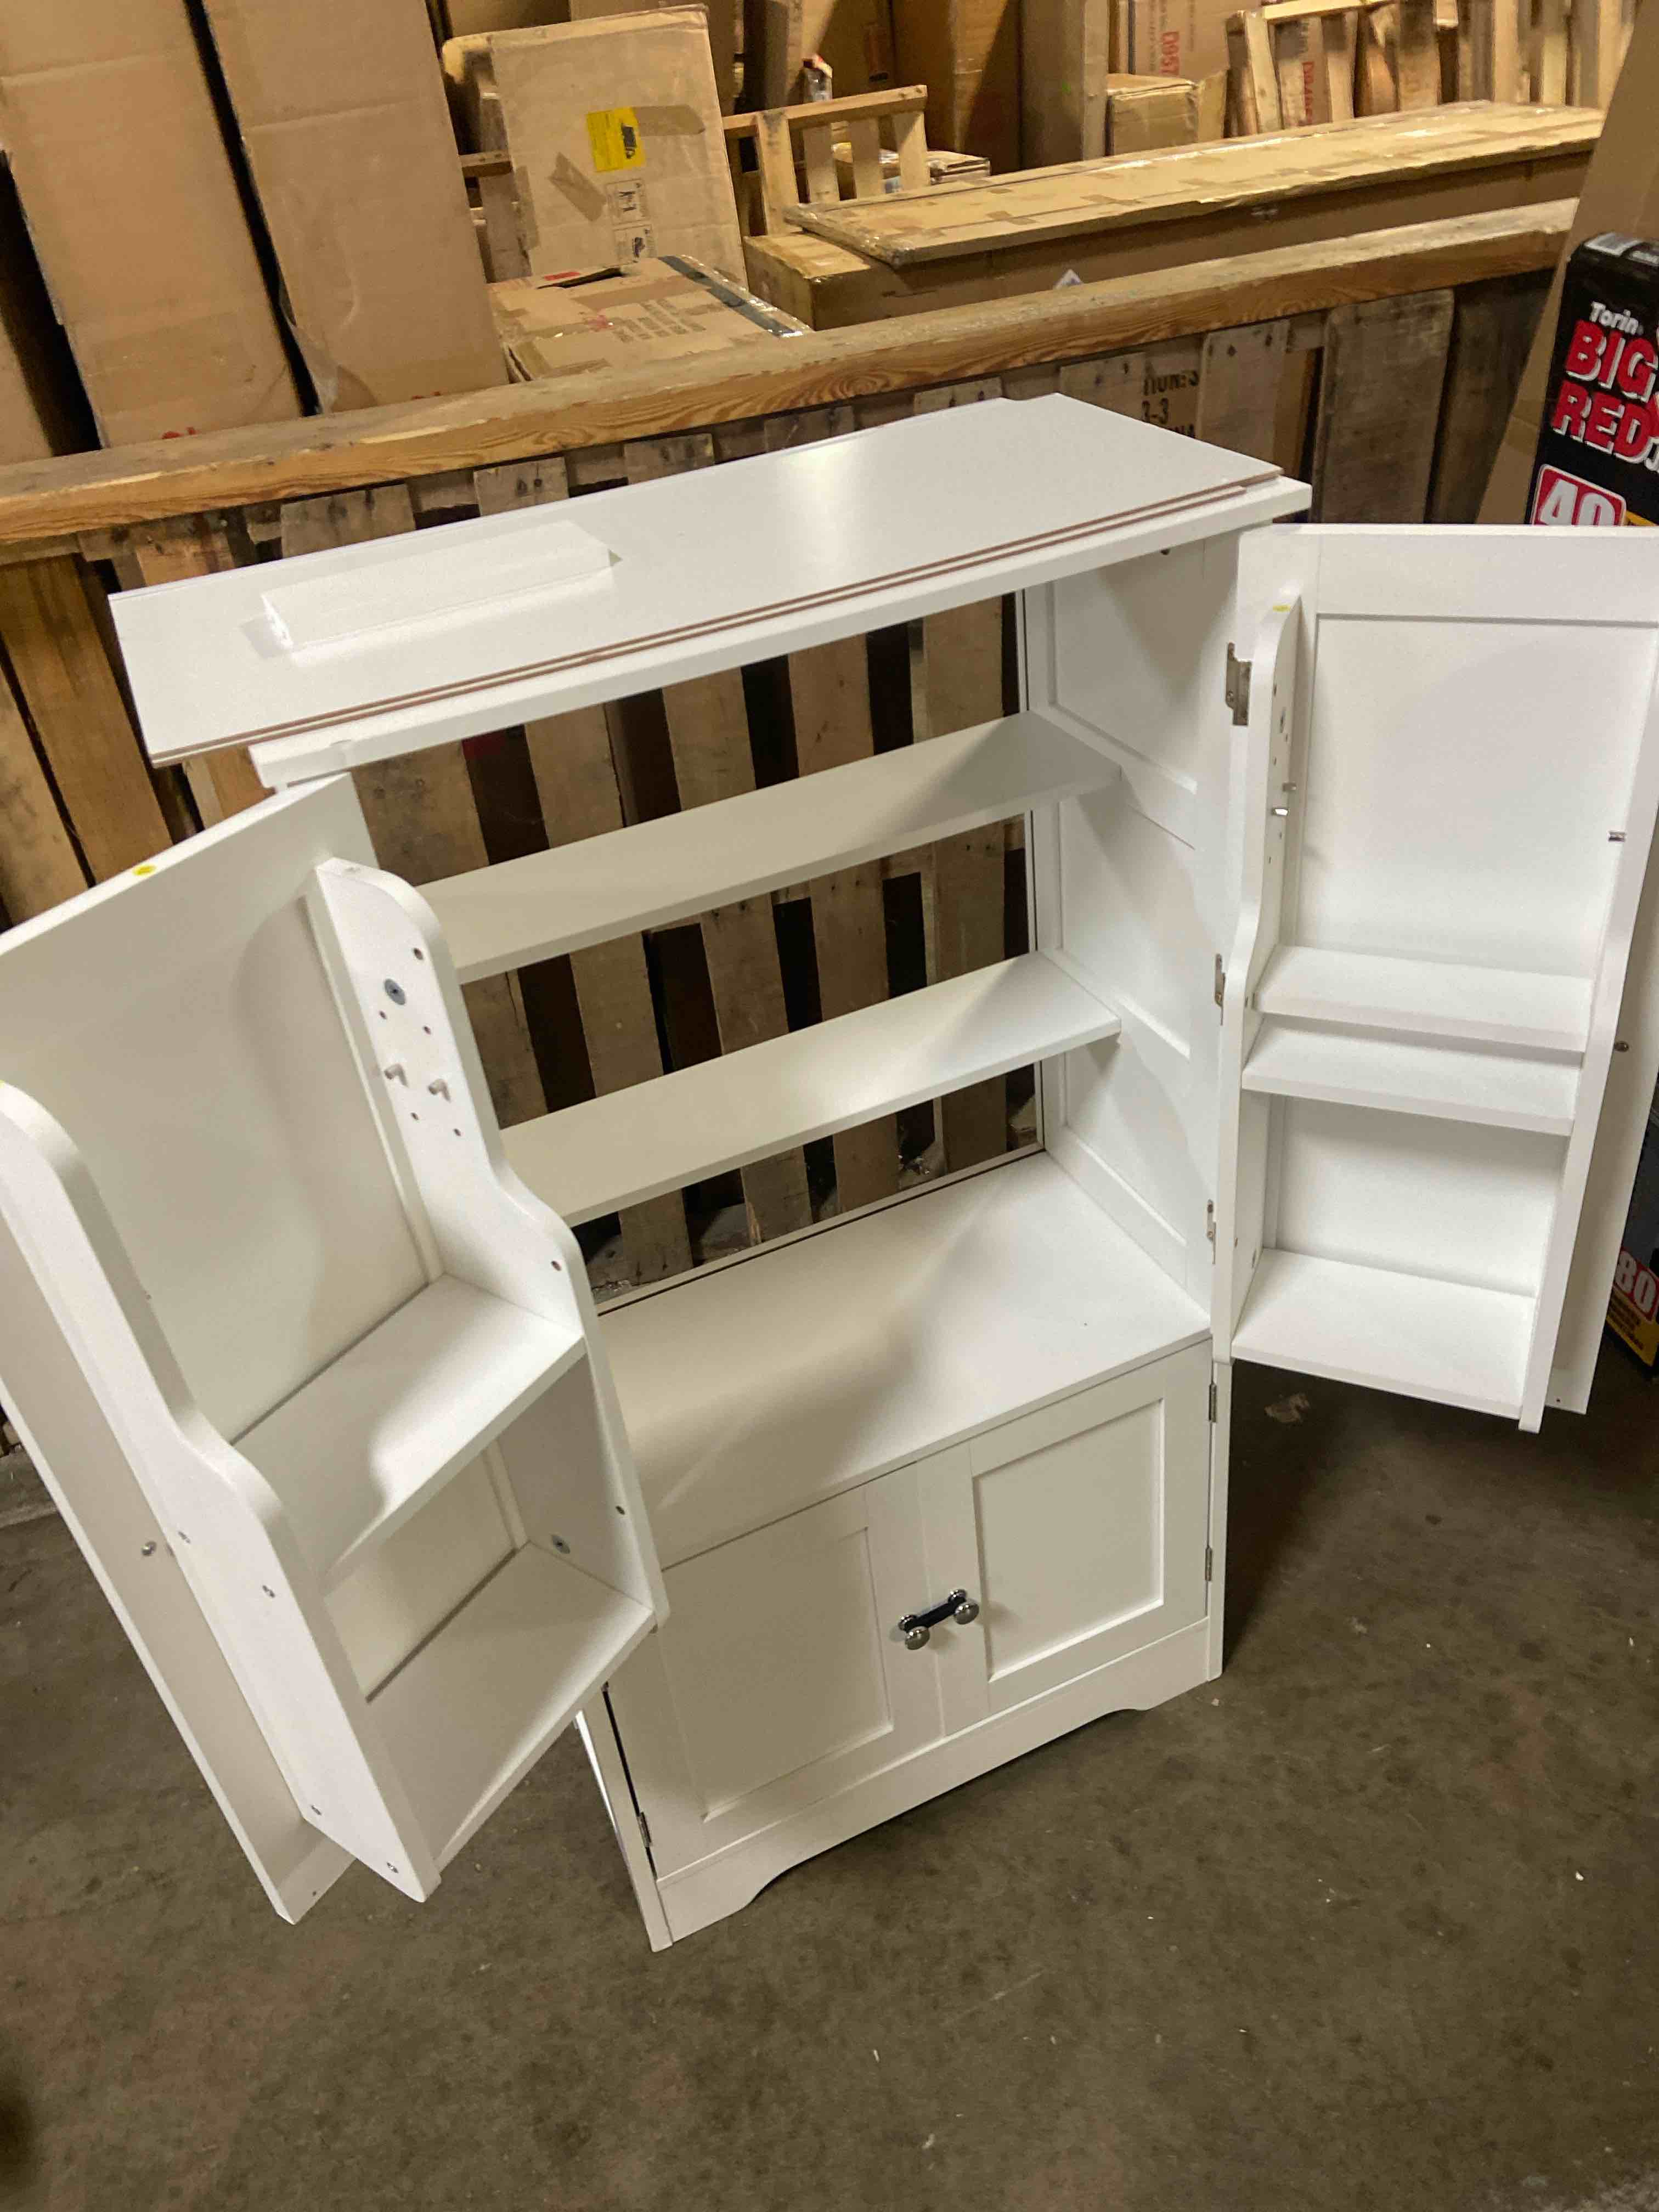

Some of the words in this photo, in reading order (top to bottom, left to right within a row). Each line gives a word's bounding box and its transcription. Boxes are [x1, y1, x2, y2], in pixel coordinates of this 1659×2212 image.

[1591, 301, 1639, 334] Torin
[1565, 320, 1658, 402] BIG
[1551, 381, 1652, 464] RED
